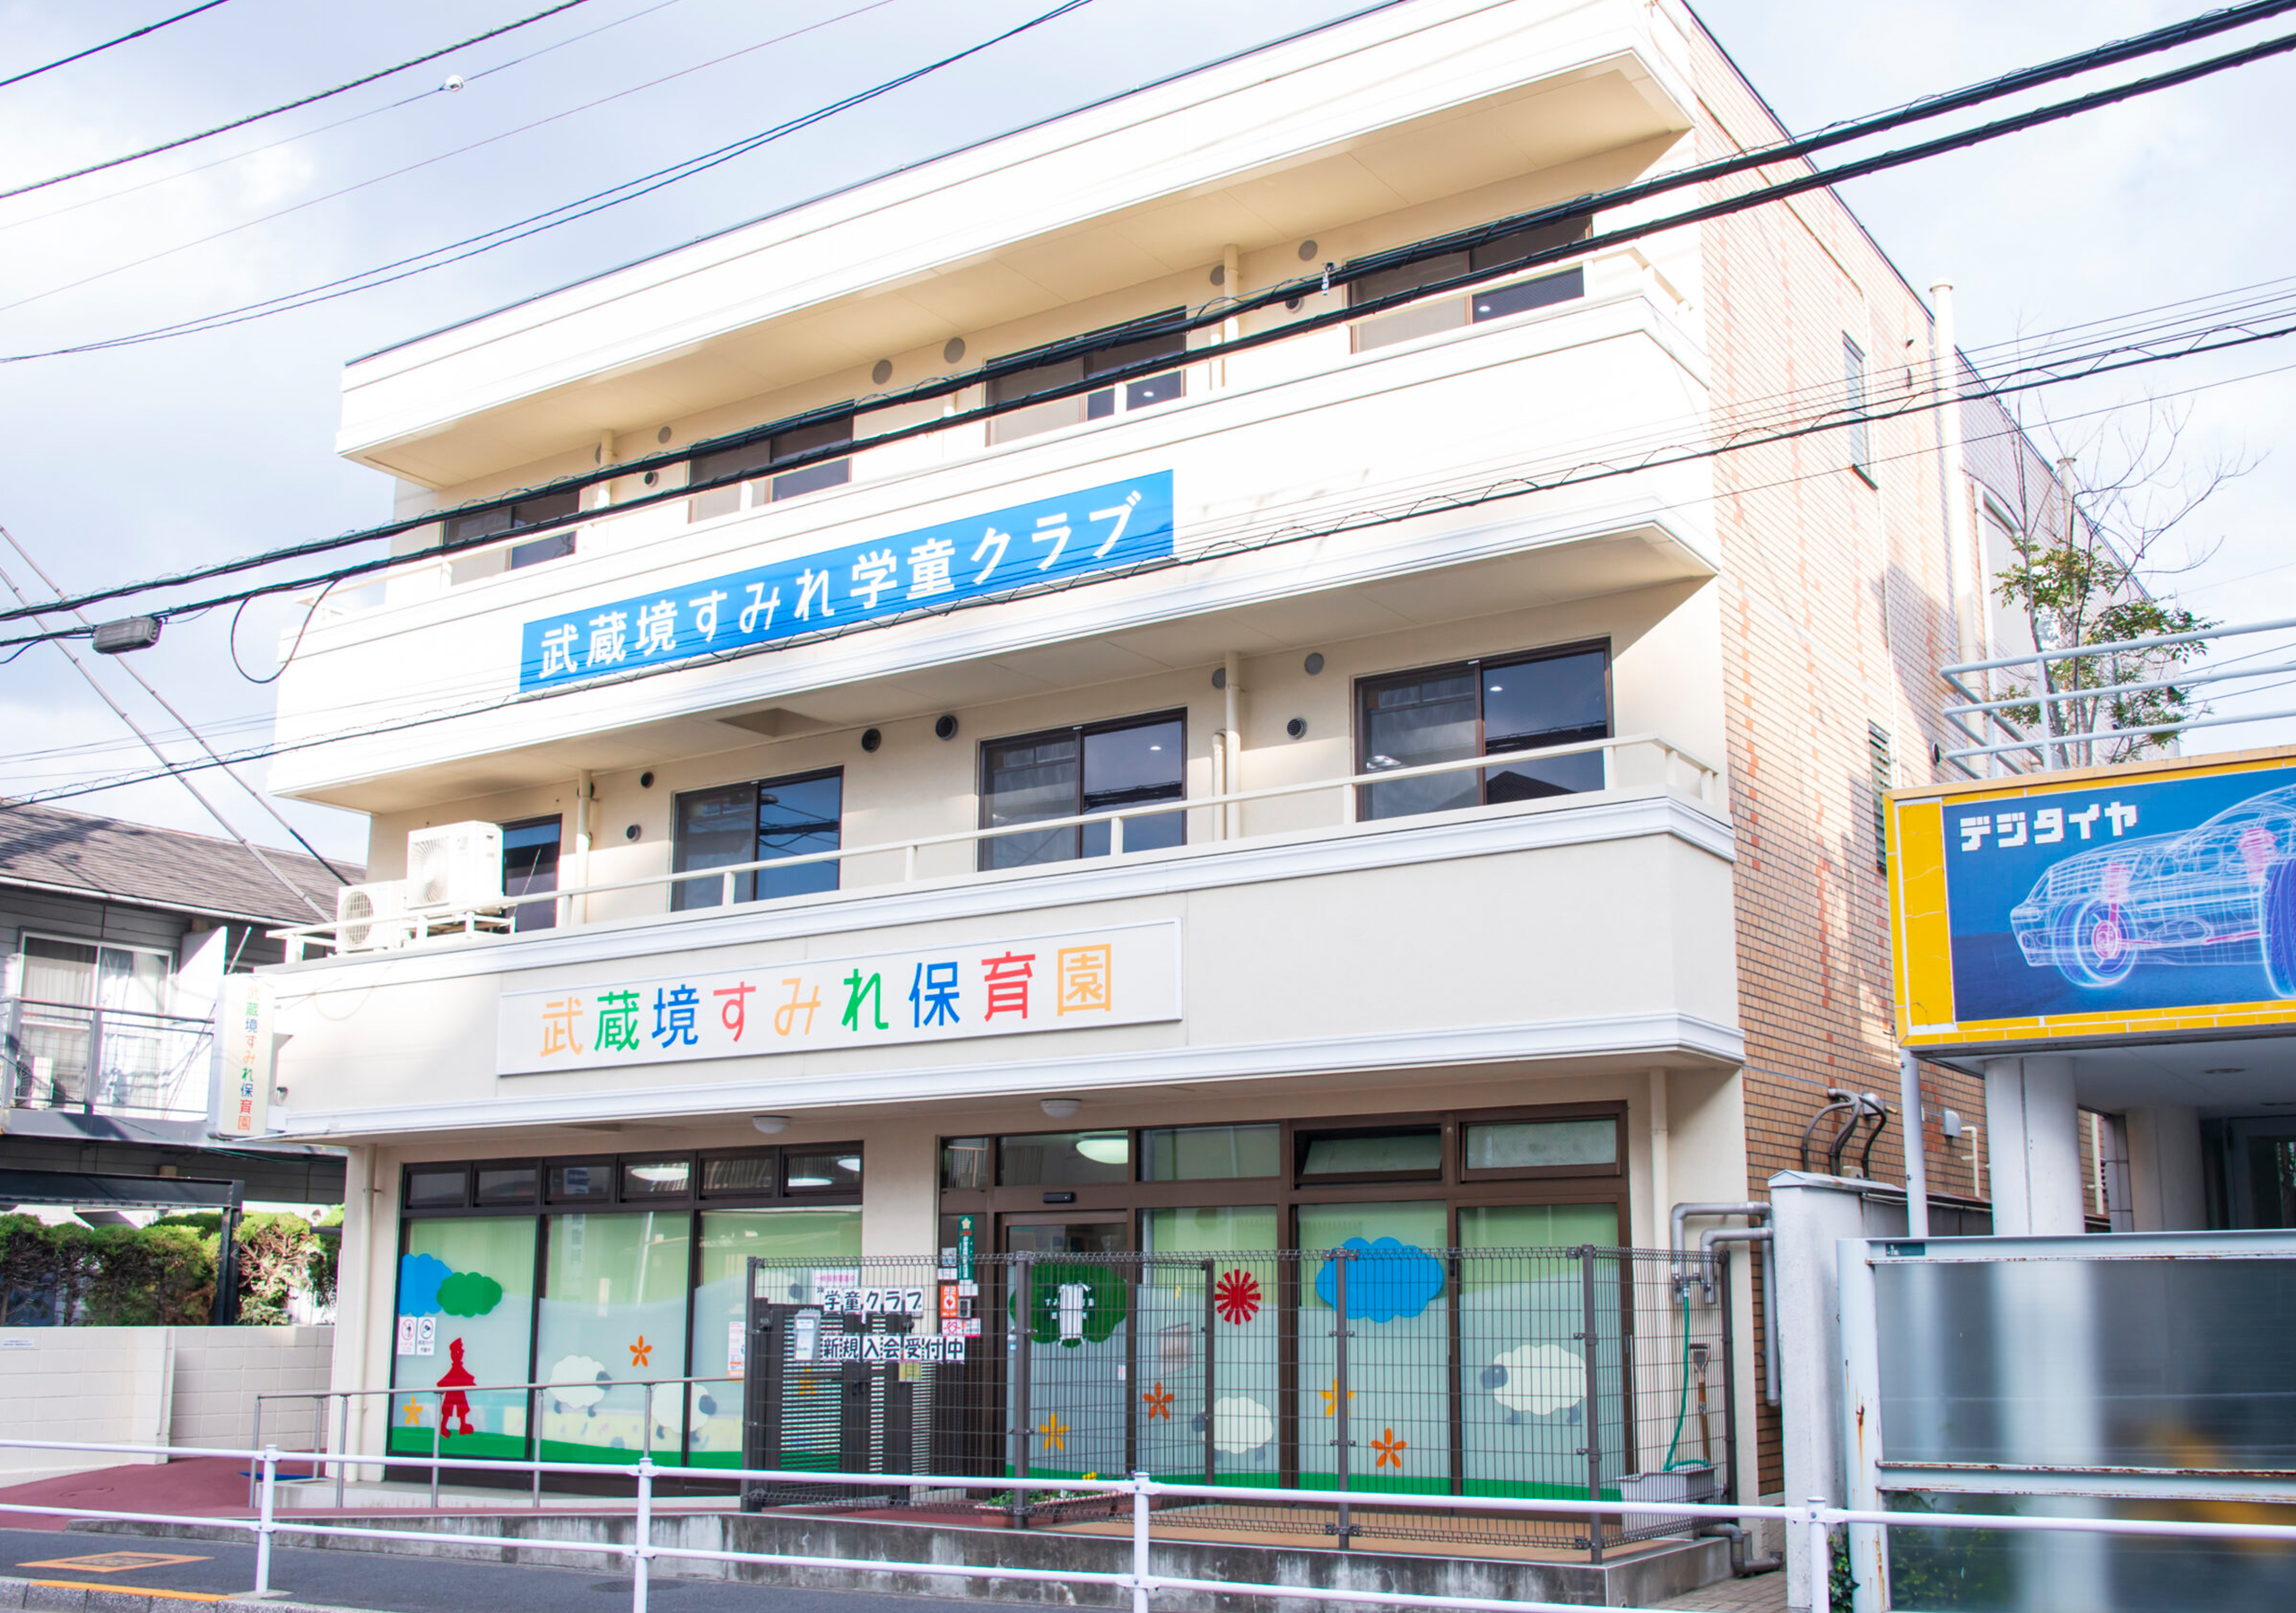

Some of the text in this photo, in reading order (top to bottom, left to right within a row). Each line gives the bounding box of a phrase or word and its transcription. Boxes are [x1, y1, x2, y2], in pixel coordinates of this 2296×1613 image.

[539, 491, 1142, 679] 武蔵境すみれ学童クラブ
[1960, 801, 2137, 852] デジタイヤ
[540, 943, 1112, 1057] 武蔵境すみれ保育園
[237, 986, 259, 1130] 武蔵境すみれ保育園
[824, 1289, 923, 1311] 学童クラブ
[822, 1337, 964, 1360] 新規入会受付中
